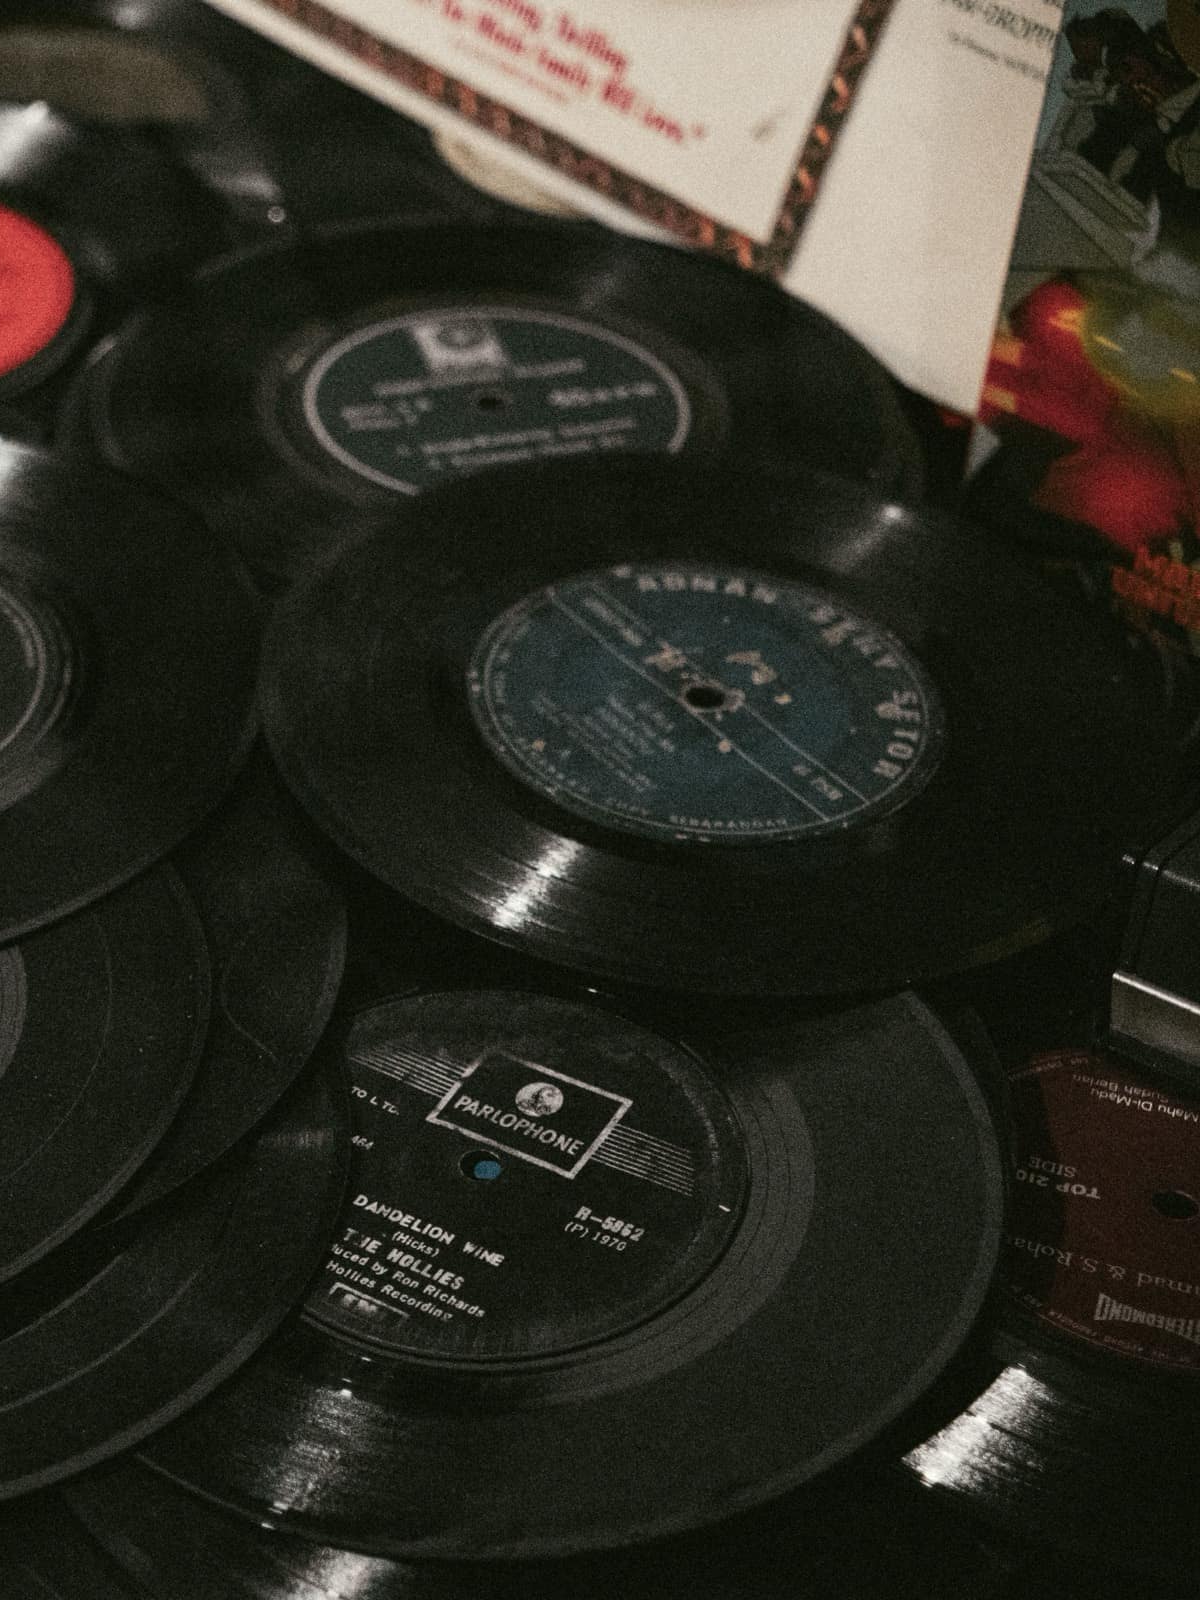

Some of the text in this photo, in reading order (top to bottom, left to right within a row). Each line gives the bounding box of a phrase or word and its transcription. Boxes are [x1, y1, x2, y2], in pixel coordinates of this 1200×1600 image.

[453, 1095, 585, 1157] PARLOPHONE
[1029, 1156, 1077, 1178] SIDE
[1016, 1169, 1101, 1200] TOP 210
[353, 1194, 505, 1267] DANDELION WINE
[391, 1231, 440, 1258] (Hicks)
[564, 1221, 627, 1251] (P) 1970
[325, 1259, 377, 1289] Hollies
[386, 1248, 465, 1290] HOLLIES
[1079, 1252, 1099, 1273] S.
[1109, 1261, 1127, 1280] &
[371, 1261, 388, 1275] by
[392, 1271, 419, 1288] Ron
[423, 1283, 486, 1318] Richards
